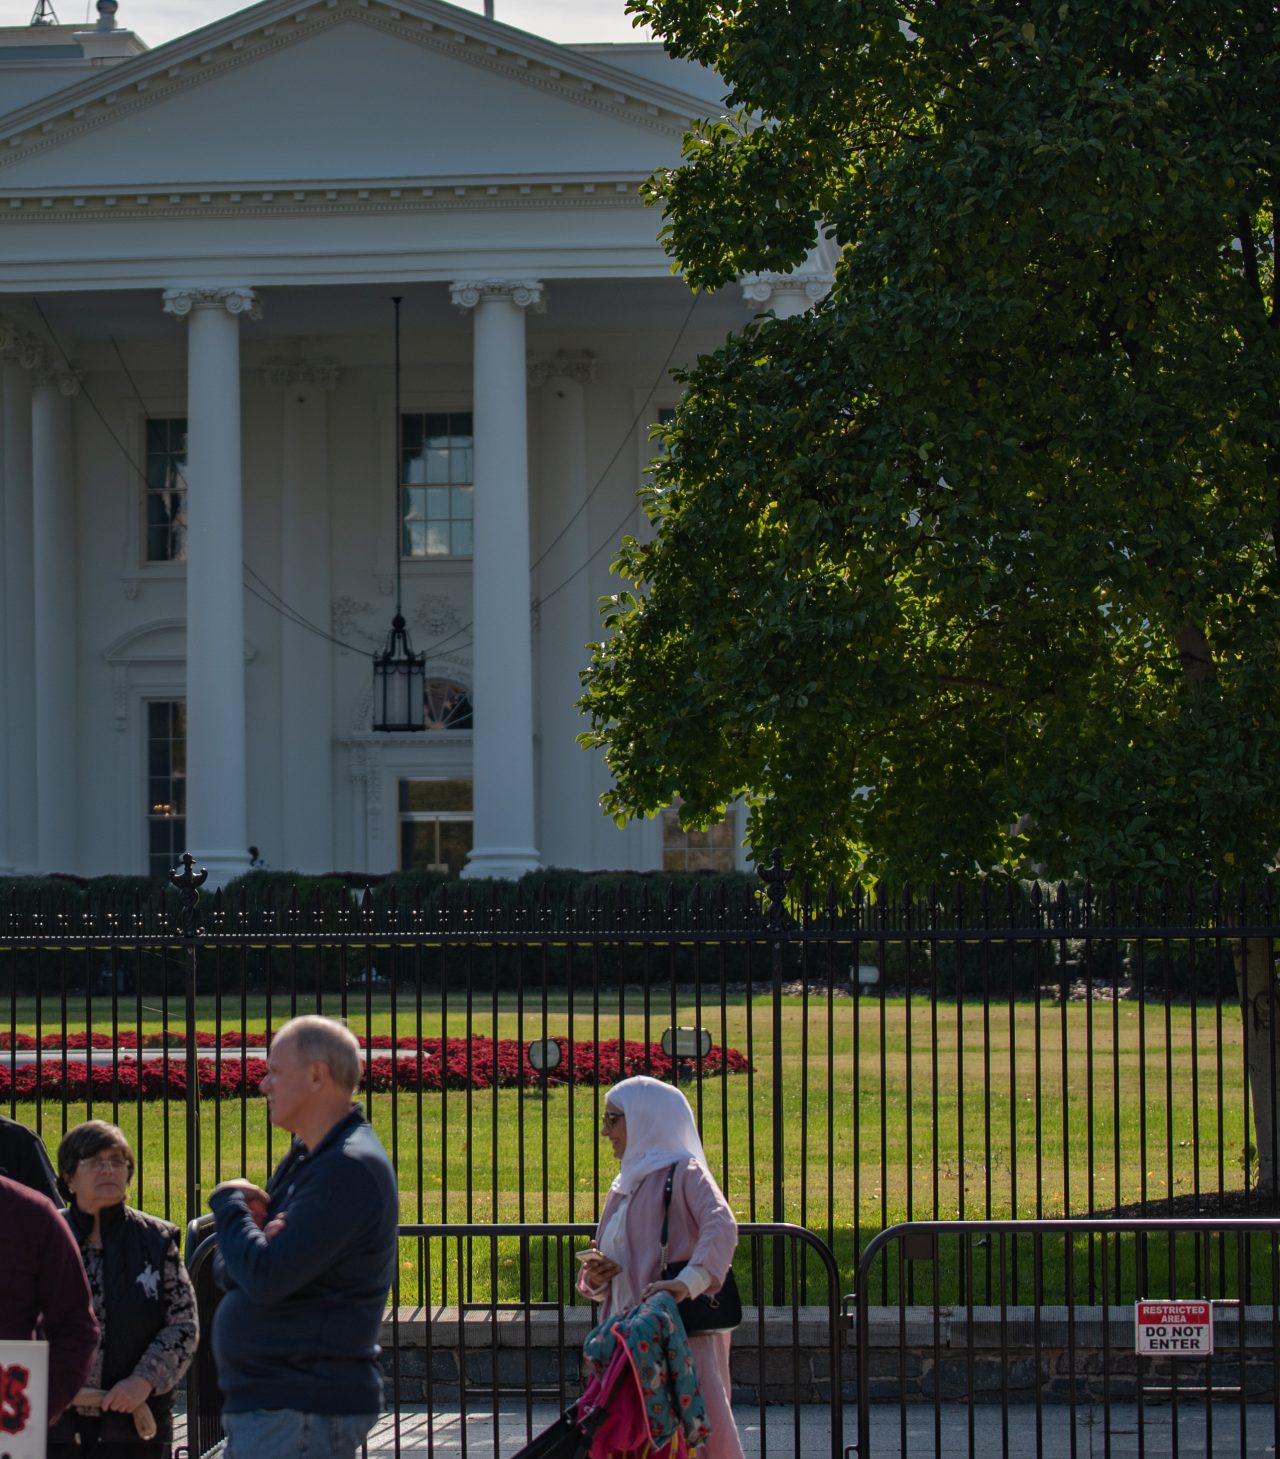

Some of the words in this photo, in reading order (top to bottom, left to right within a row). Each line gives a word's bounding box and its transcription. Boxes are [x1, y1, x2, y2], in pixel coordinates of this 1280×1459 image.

[1143, 1306, 1205, 1314] RESTRICTED
[1161, 1315, 1187, 1323] AREA
[1146, 1326, 1166, 1337] DO
[1172, 1326, 1203, 1337] NOT
[1150, 1339, 1200, 1349] ENTER
